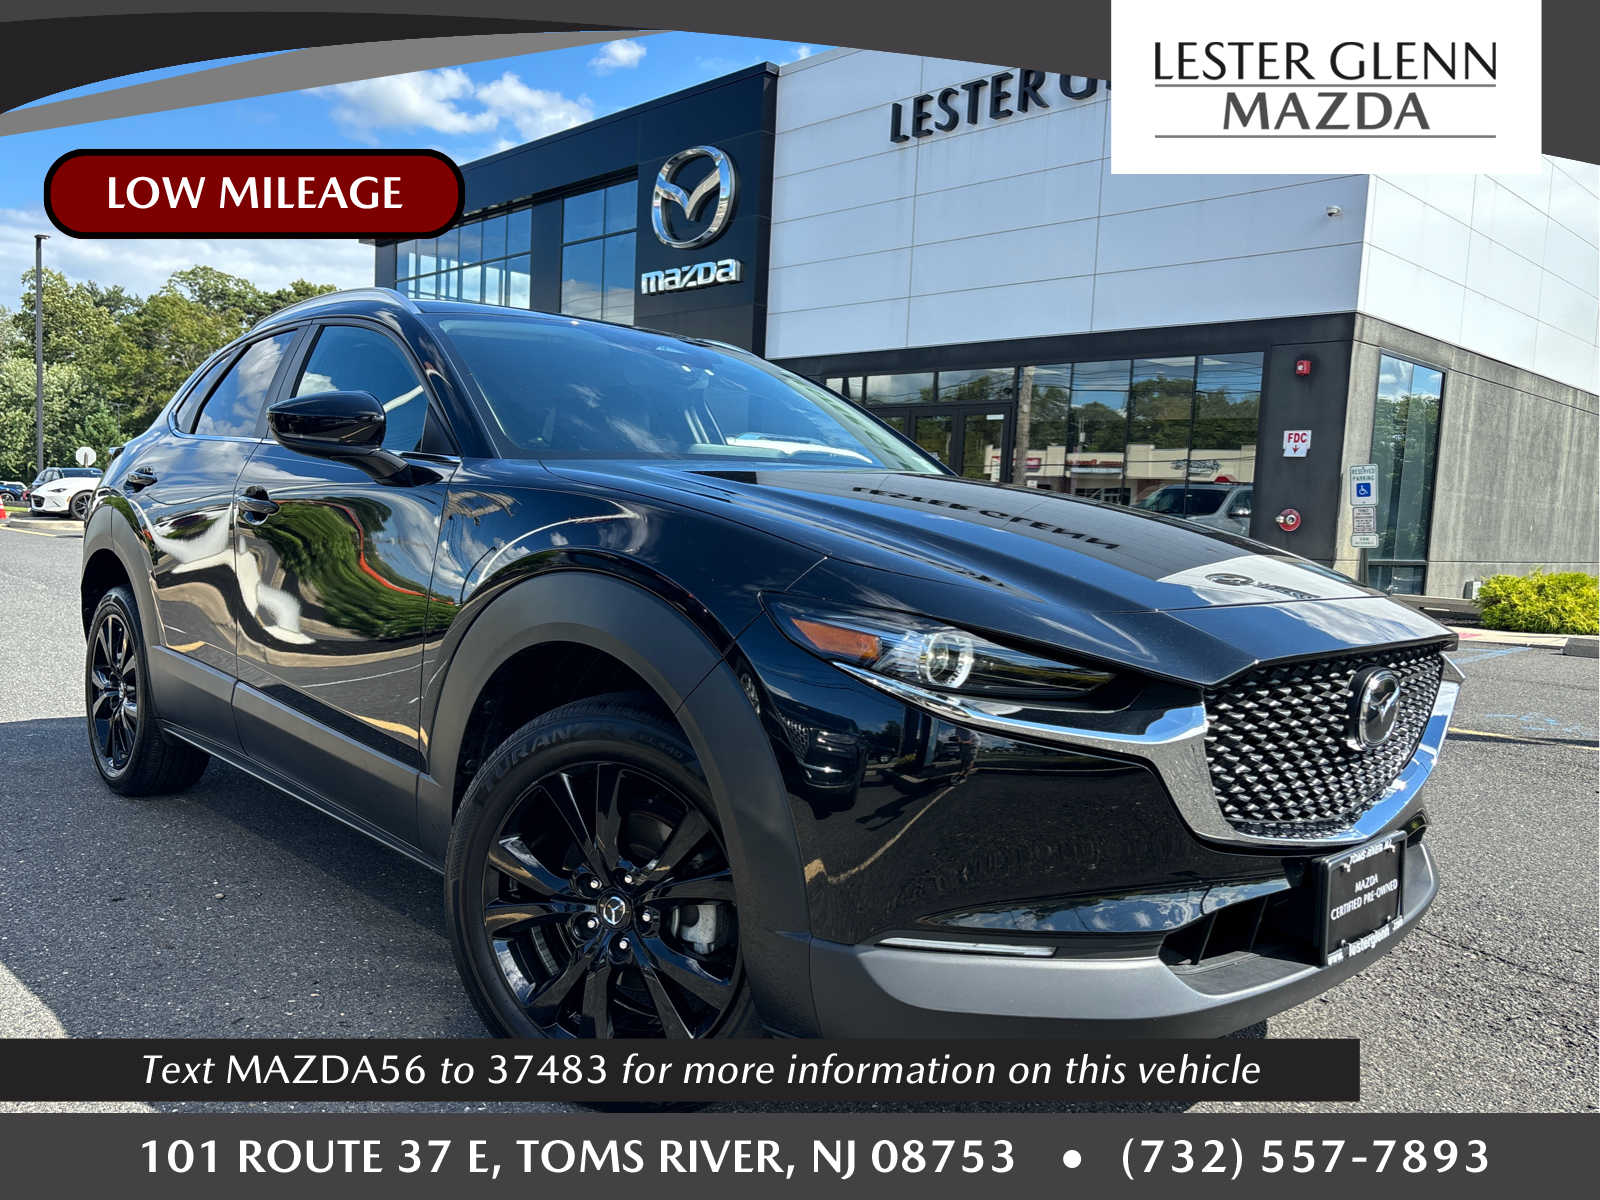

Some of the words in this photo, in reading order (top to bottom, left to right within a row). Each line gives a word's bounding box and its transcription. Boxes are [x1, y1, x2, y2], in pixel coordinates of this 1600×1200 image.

[890, 67, 1049, 144] LESTER
[1287, 432, 1307, 444] FDC
[1355, 873, 1379, 893] MAZDA
[1330, 896, 1362, 921] CERTIFIED
[1363, 879, 1398, 905] PRE-OWNED
